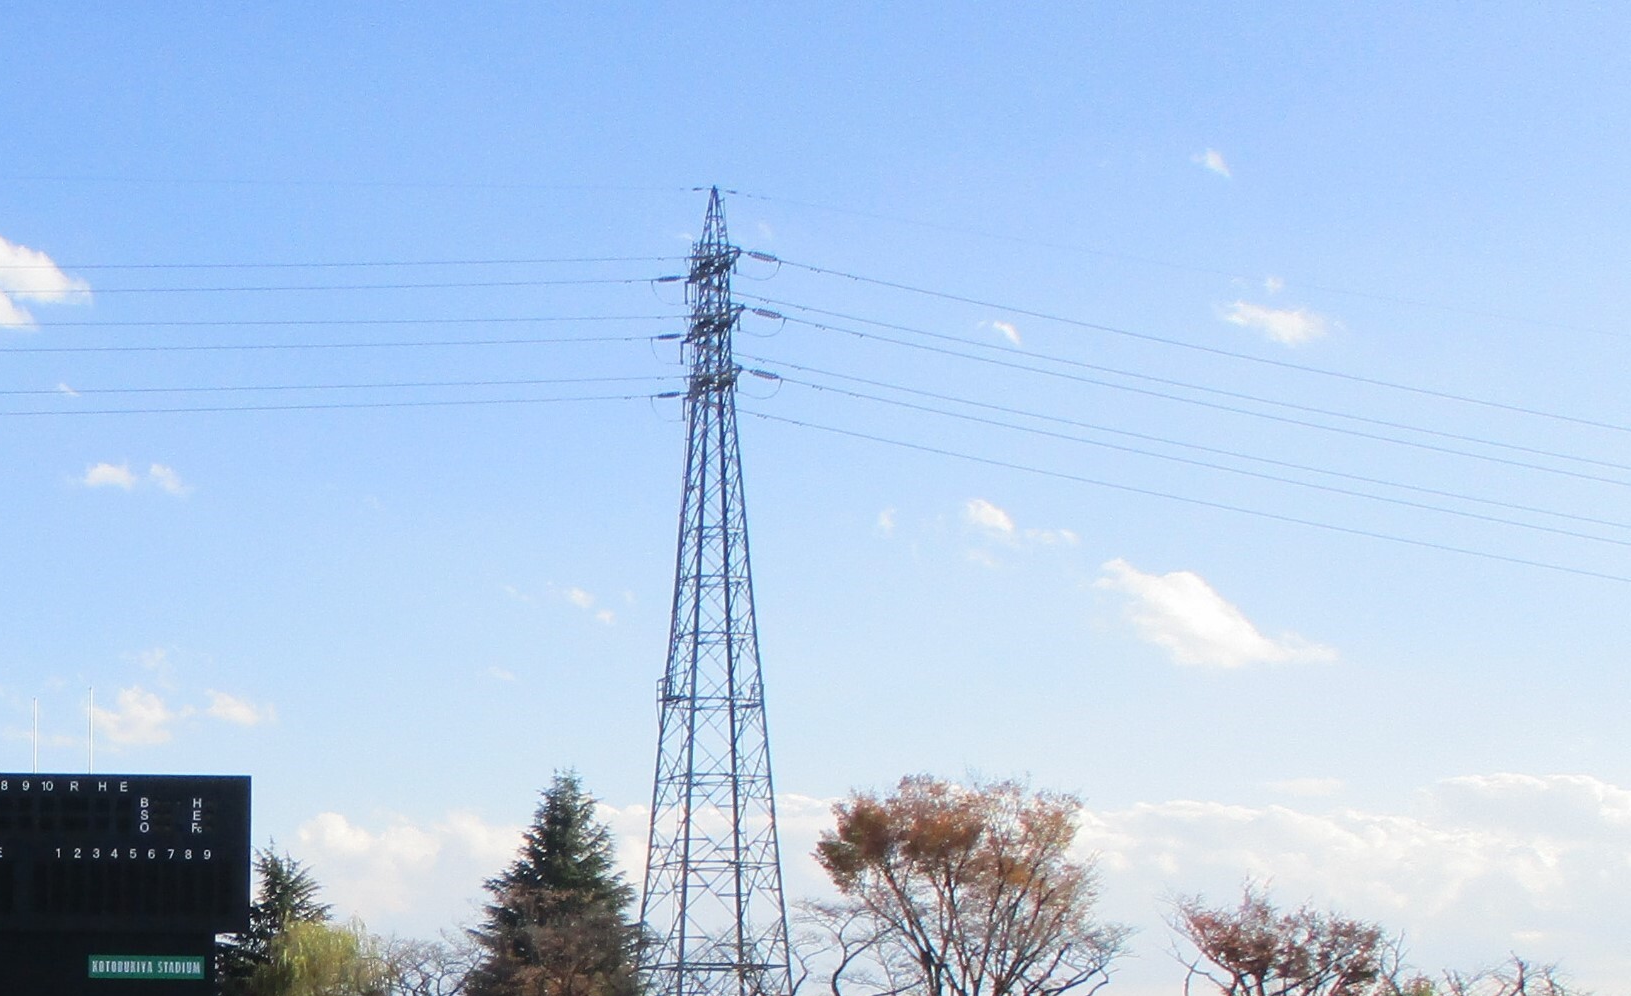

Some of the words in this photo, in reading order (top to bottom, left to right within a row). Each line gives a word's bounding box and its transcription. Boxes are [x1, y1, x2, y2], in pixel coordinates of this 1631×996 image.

[0, 779, 9, 791] 8
[21, 780, 30, 791] 9
[41, 780, 54, 792] 10
[69, 780, 79, 792] R
[98, 781, 107, 792] H
[119, 780, 128, 793] E
[140, 796, 149, 809] B
[192, 797, 202, 809] H
[140, 809, 149, 821] S
[192, 809, 202, 821] E
[139, 821, 150, 833] O
[73, 847, 82, 859] 2
[92, 847, 100, 859] 3
[110, 848, 119, 859] 4
[129, 848, 137, 859] 5
[147, 848, 156, 860] 6
[167, 848, 175, 860] 7
[184, 848, 193, 860] 8
[203, 849, 212, 860] 9
[92, 960, 153, 973] KOTOBUKIYA
[157, 961, 201, 974] STADIUM
